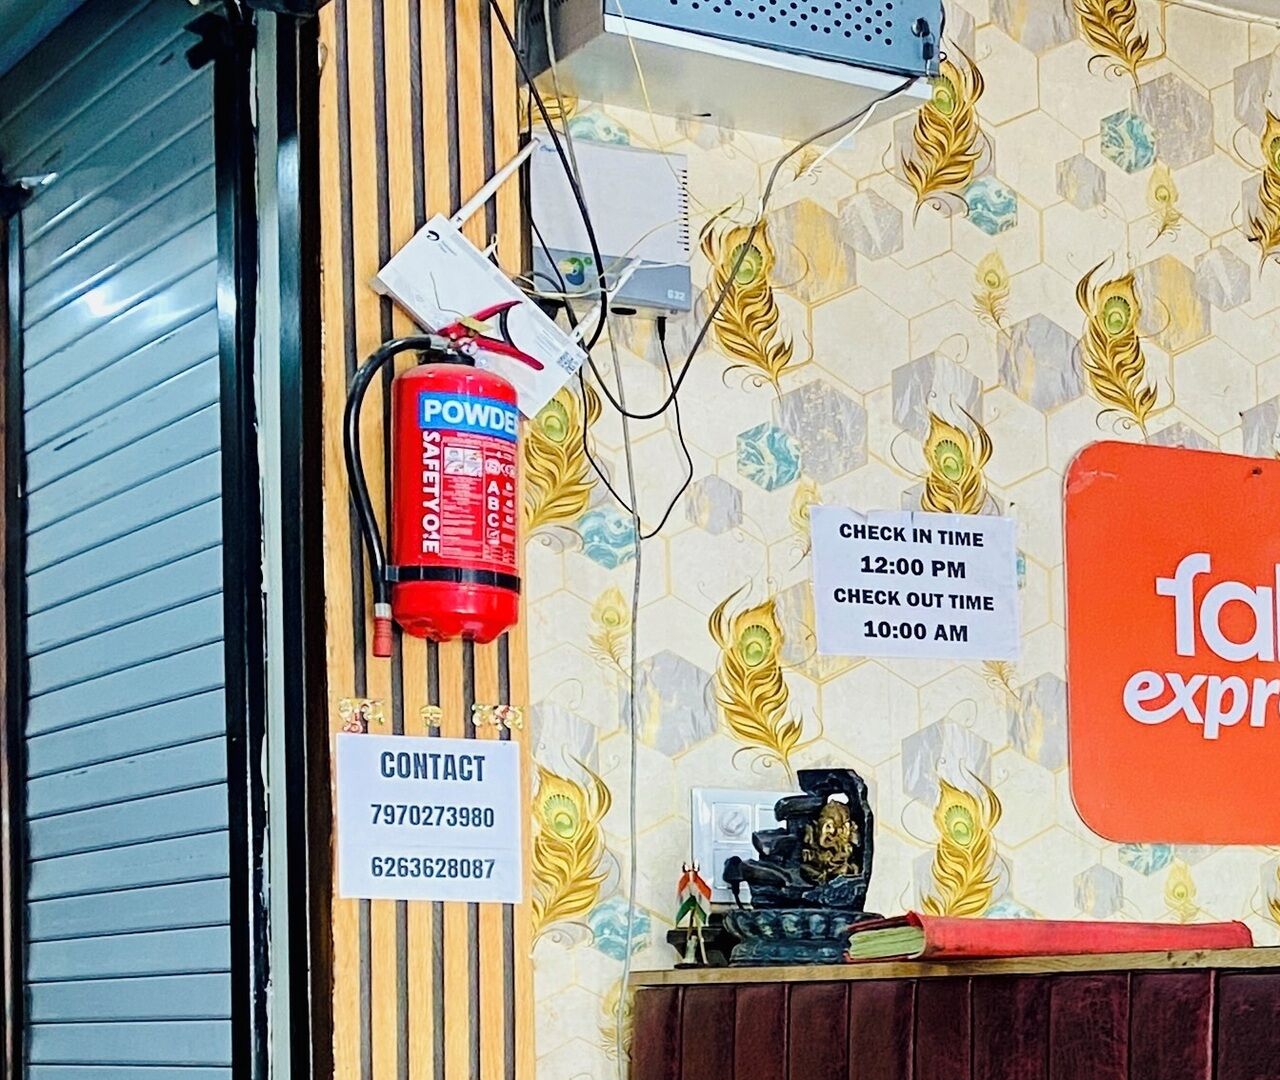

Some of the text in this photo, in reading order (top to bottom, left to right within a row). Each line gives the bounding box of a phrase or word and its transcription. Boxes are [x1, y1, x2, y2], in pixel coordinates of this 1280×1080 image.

[424, 399, 518, 434] POWDE
[840, 524, 983, 547] CHECK IN TIME
[861, 556, 965, 578] 12:00 PM
[834, 588, 994, 611] CHECK OUT TIME
[864, 621, 967, 642] 10:00 AM
[381, 752, 485, 781] CONTACT
[371, 804, 493, 827] 7970273980
[372, 857, 494, 878] 6263628087
